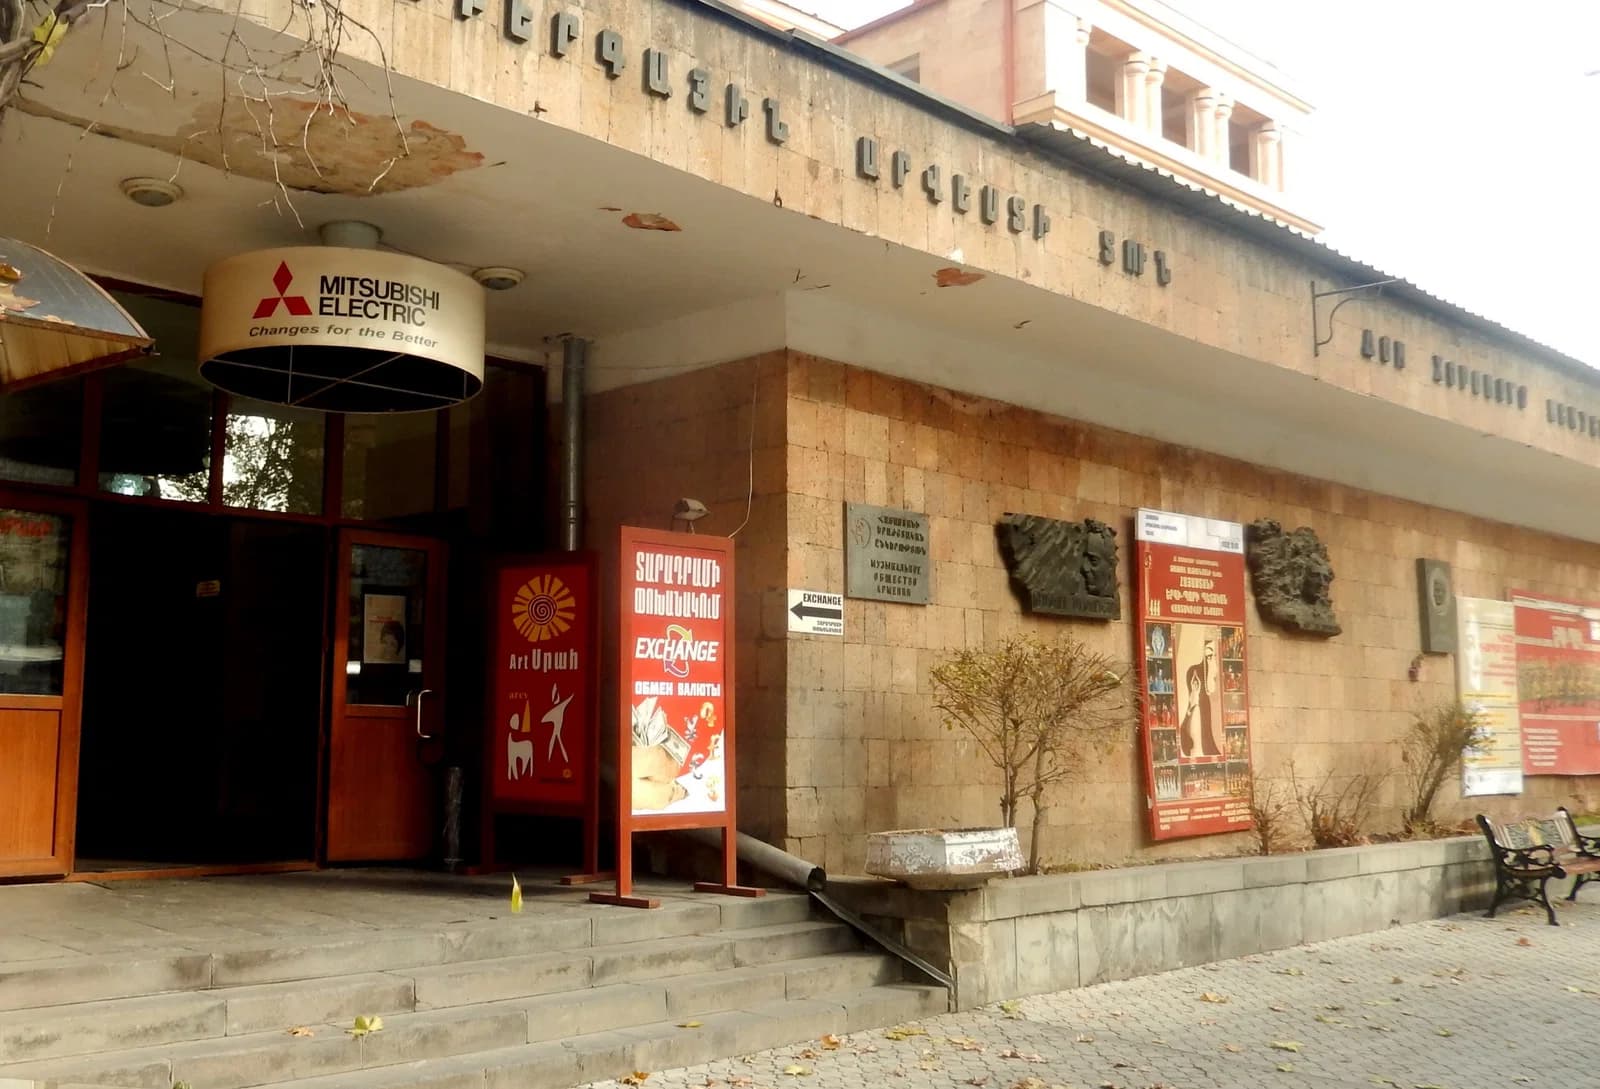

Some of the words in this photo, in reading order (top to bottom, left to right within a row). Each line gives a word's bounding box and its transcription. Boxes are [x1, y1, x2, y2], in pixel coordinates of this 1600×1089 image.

[856, 136, 1051, 240] ԱՐՎԵՍՏԻ
[320, 275, 439, 310] MITSUBISHI
[319, 297, 426, 326] ELECTRIC
[249, 325, 319, 337] Changes
[327, 324, 352, 336] for
[359, 327, 385, 339] the
[392, 331, 438, 348] Better
[635, 551, 721, 588] ՏԱՐԱԴՐԱՄԻ
[871, 560, 921, 575] МУЗЫКАЛЬНОЕ
[874, 572, 917, 586] ОБЩЕСТВО
[803, 593, 842, 606] EXCHANGE
[509, 653, 528, 670] Art
[635, 637, 719, 662] EXCHANGE
[634, 680, 674, 695] ОБМЕН
[678, 682, 721, 697] ВАЛЮТЫ
